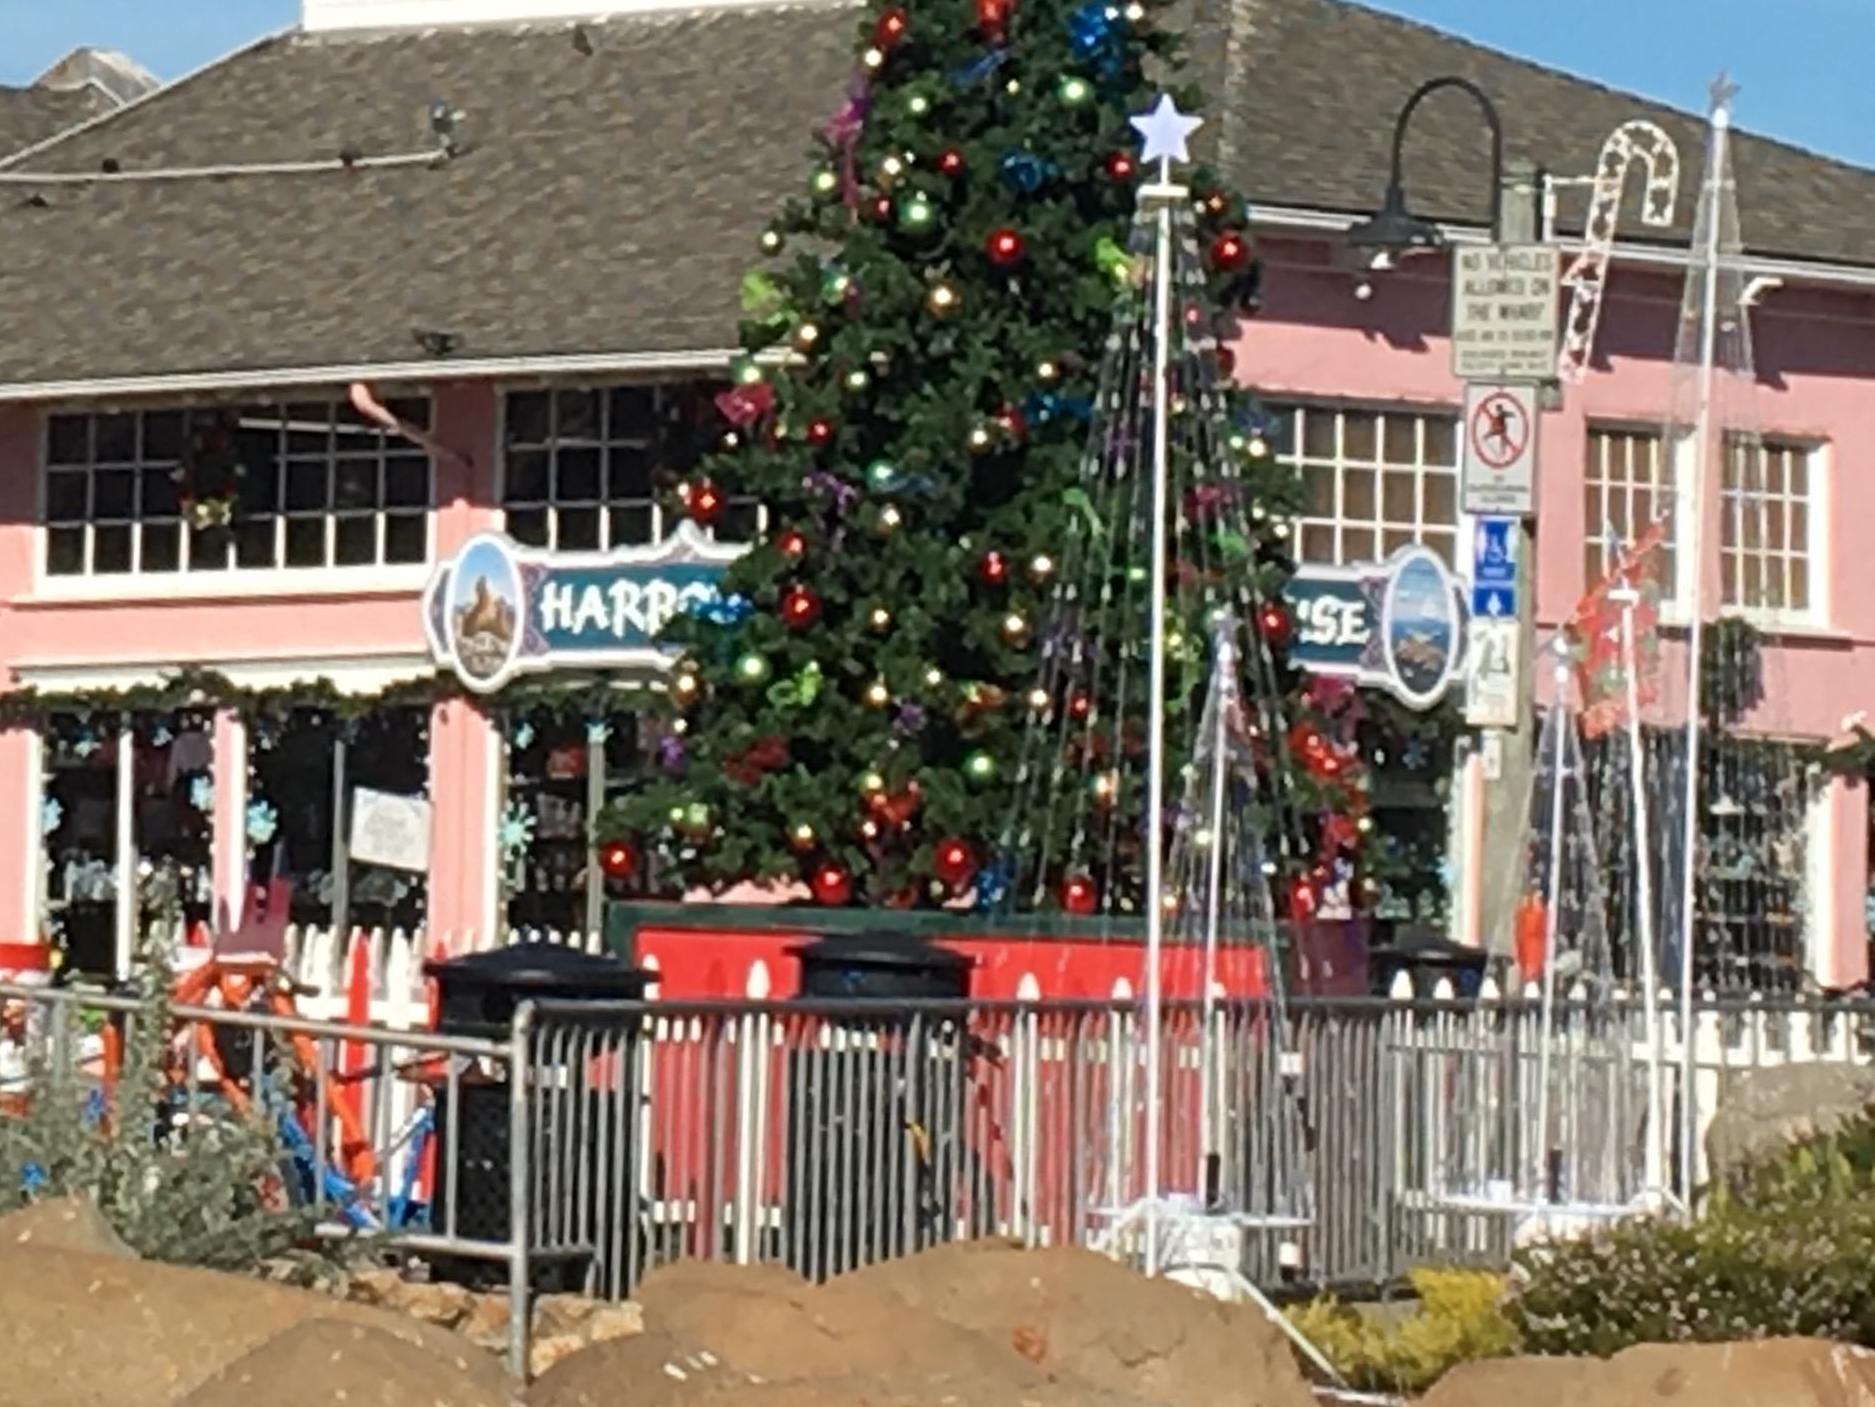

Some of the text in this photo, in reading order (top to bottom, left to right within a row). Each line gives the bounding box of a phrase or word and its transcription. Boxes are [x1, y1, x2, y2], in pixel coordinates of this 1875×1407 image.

[1486, 253, 1553, 271] VEHICLES
[1463, 278, 1524, 296] ALLOWED
[1467, 303, 1490, 320] THE
